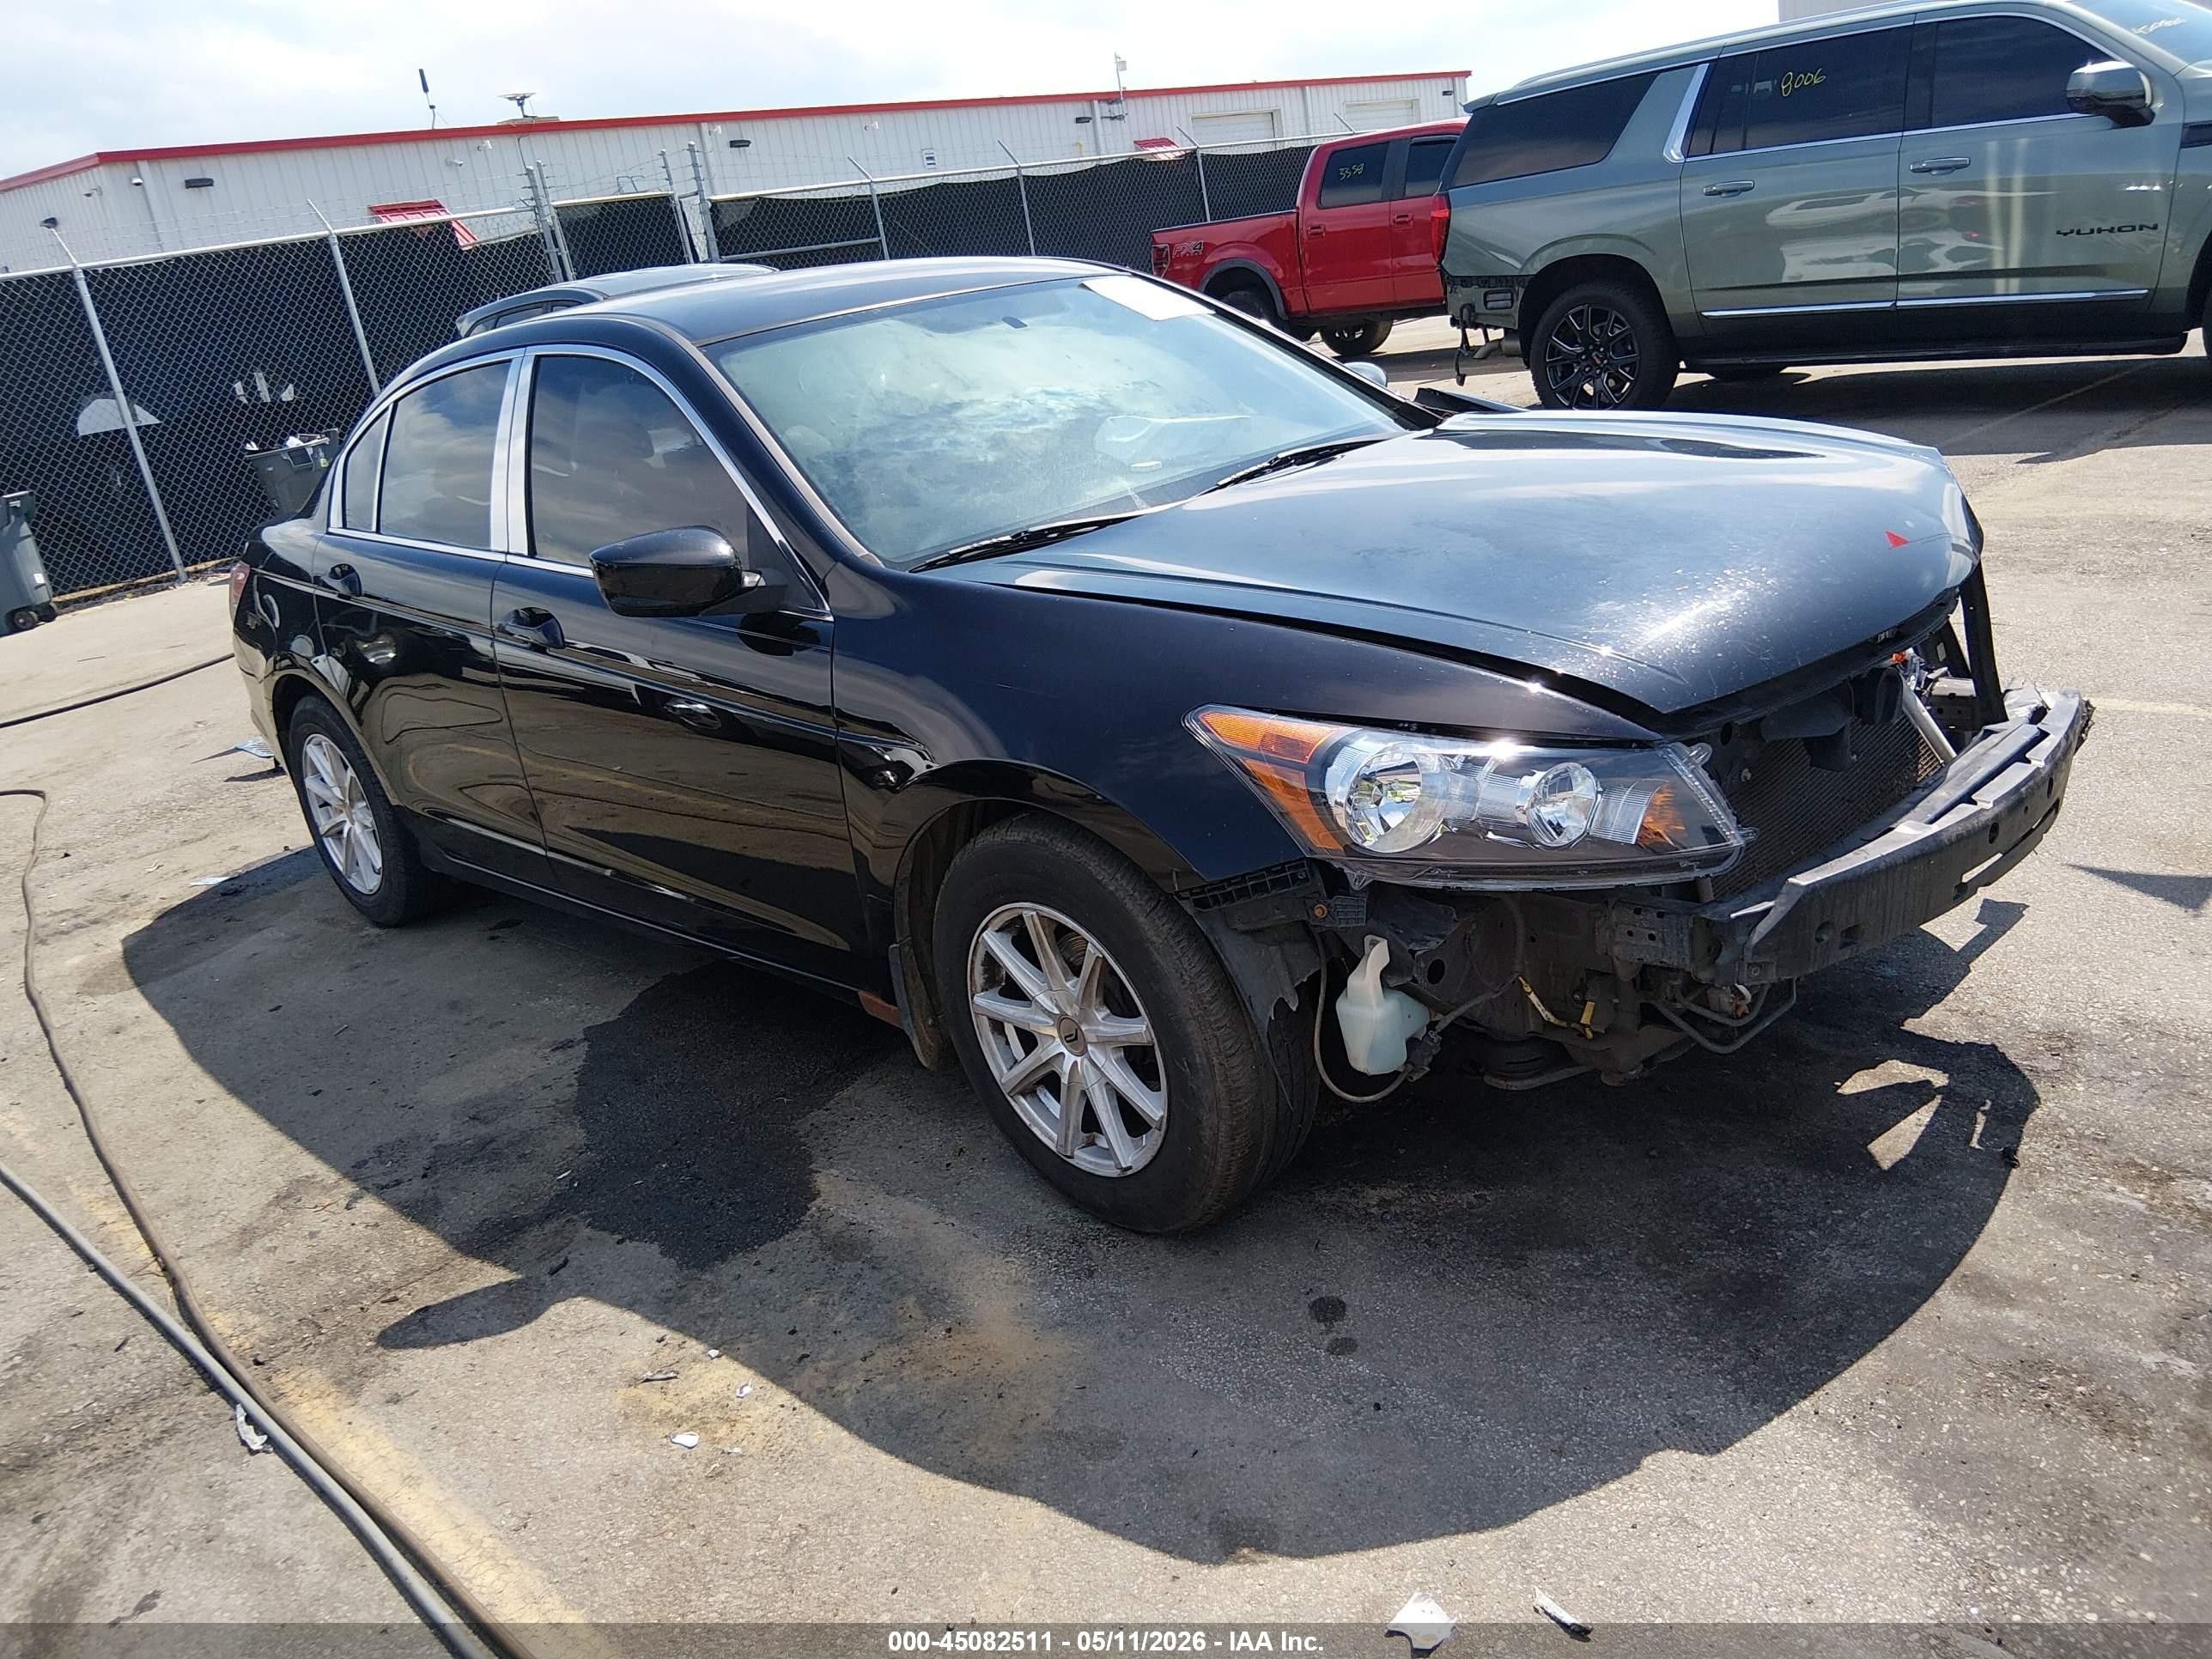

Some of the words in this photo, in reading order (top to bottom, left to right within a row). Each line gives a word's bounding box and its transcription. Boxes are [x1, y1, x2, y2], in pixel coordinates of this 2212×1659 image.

[1781, 68, 1827, 97] 8006
[2056, 223, 2159, 237] YUKON
[1172, 240, 1204, 256] FX4
